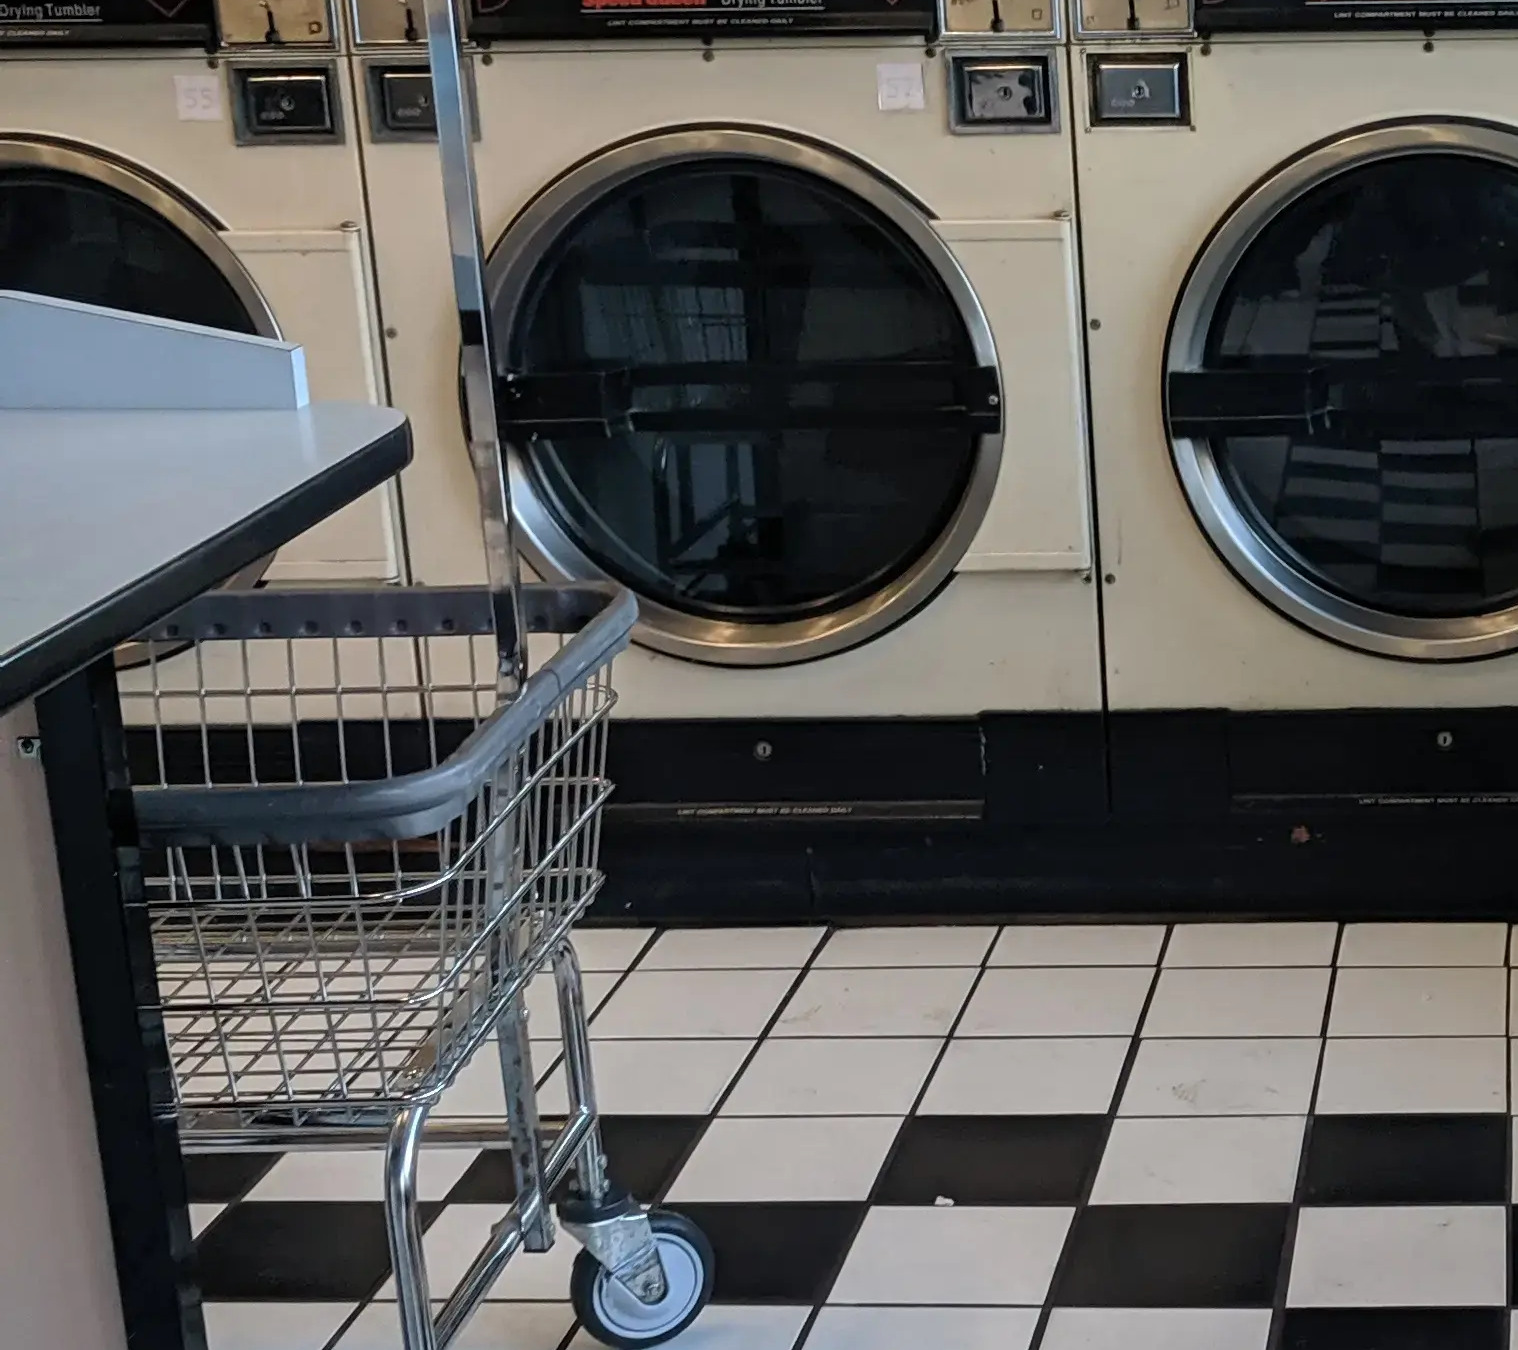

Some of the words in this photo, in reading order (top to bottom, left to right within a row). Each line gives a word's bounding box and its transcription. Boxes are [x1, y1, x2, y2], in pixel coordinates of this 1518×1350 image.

[0, 4, 43, 19] Drying
[44, 3, 101, 17] Tumbler
[1334, 11, 1352, 19] LINT
[1355, 11, 1416, 19] COMPARTMENT
[1419, 11, 1442, 19] MUST
[1444, 11, 1455, 19] BE
[1457, 11, 1496, 19] CLEANED
[184, 87, 213, 110] 55
